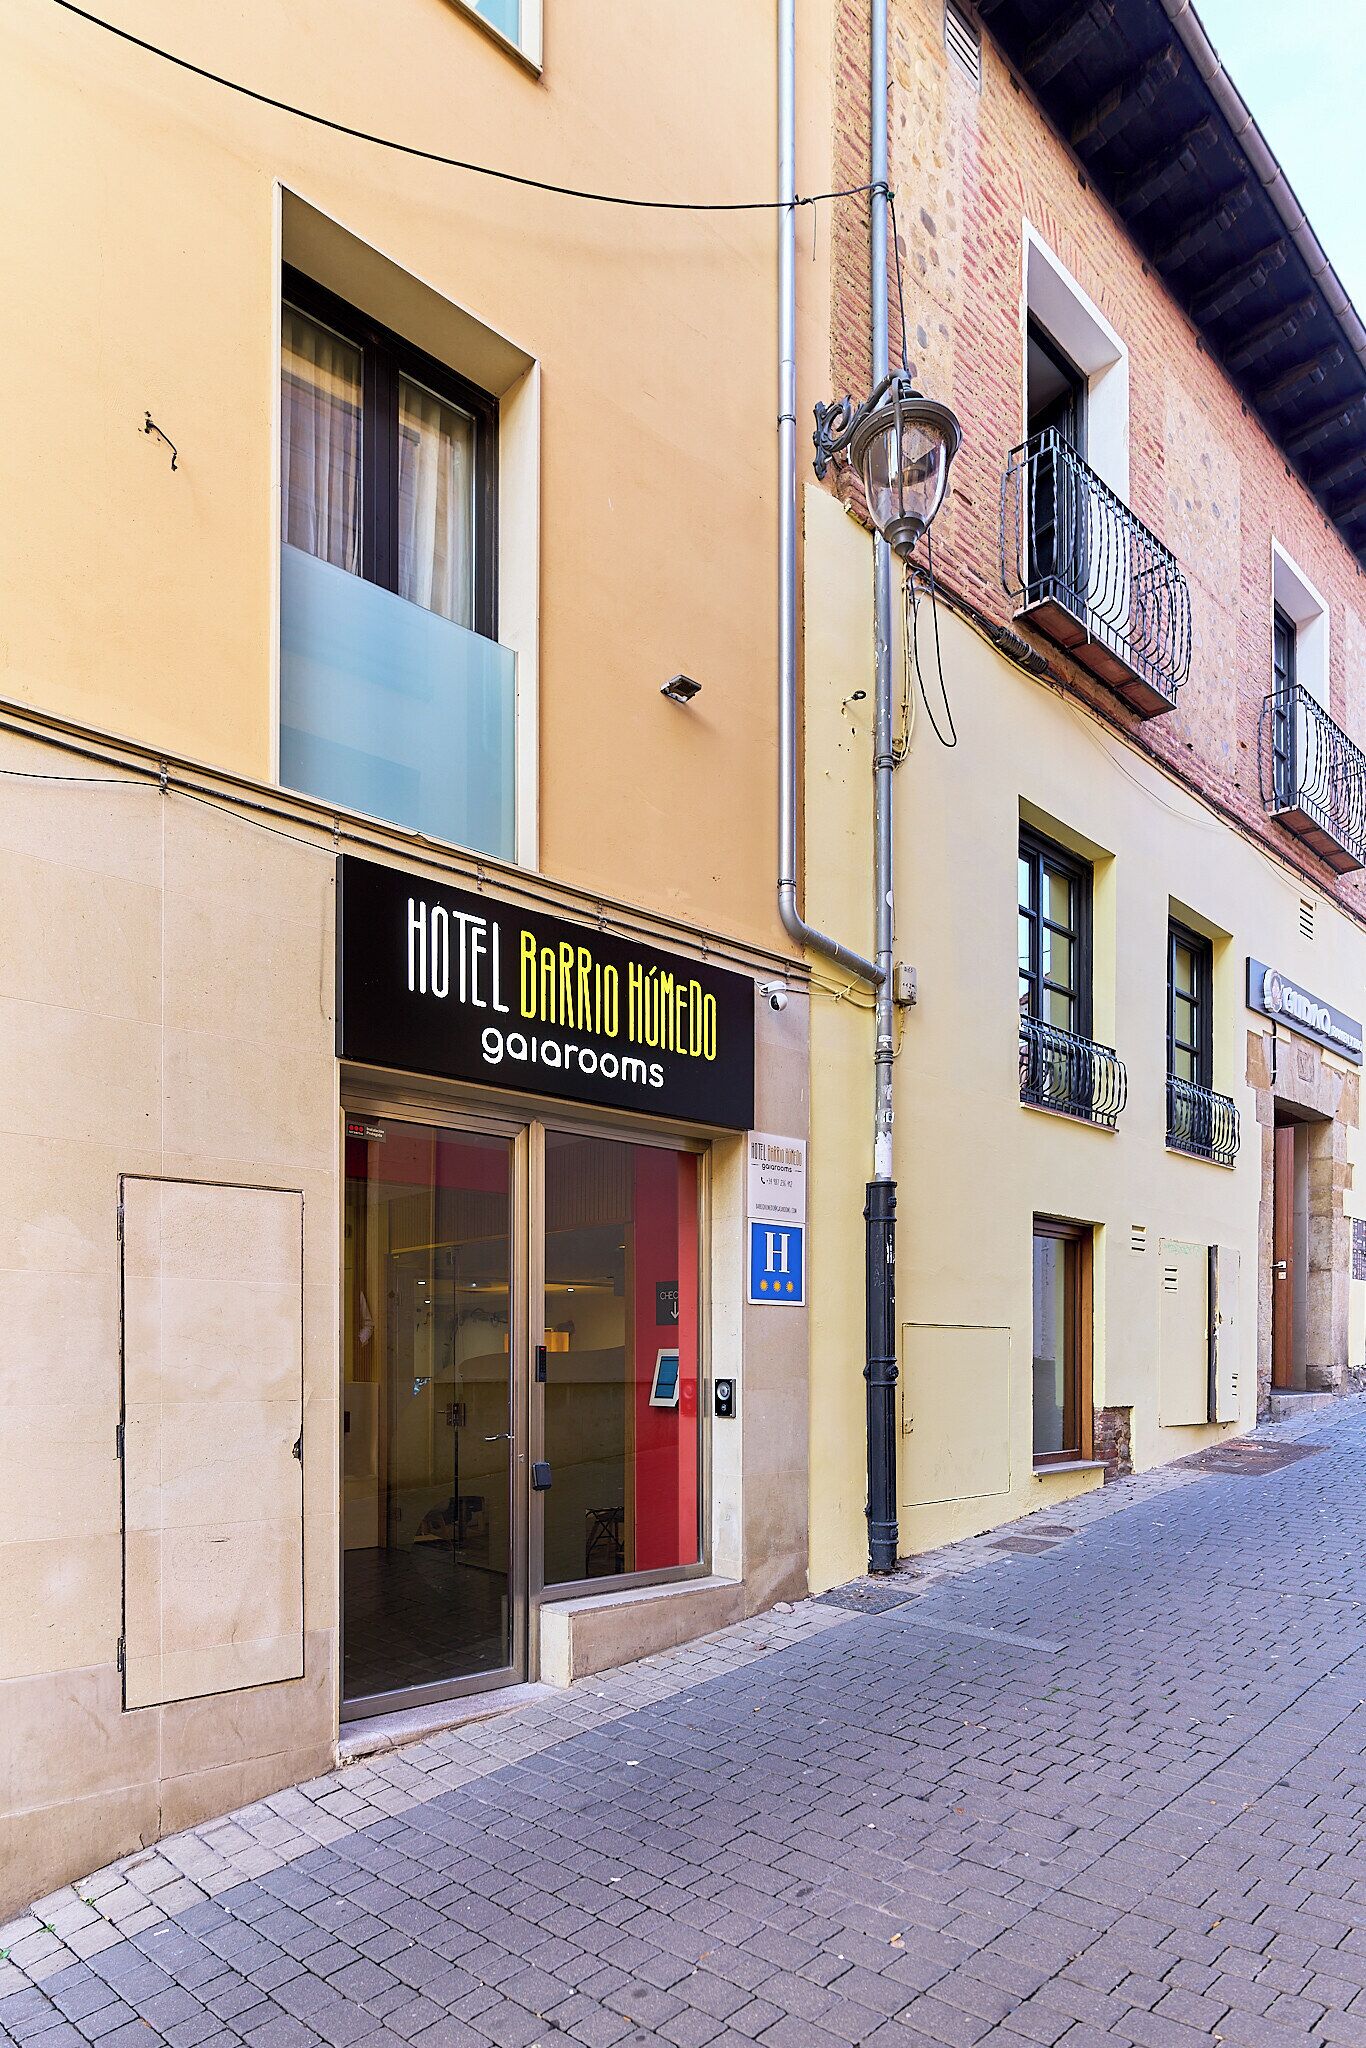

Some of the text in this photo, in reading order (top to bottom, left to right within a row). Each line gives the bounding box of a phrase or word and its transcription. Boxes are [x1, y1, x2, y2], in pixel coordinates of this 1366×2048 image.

[520, 929, 620, 1039] BARRIO
[481, 1026, 665, 1089] gaiarooms
[764, 1231, 791, 1273] H
